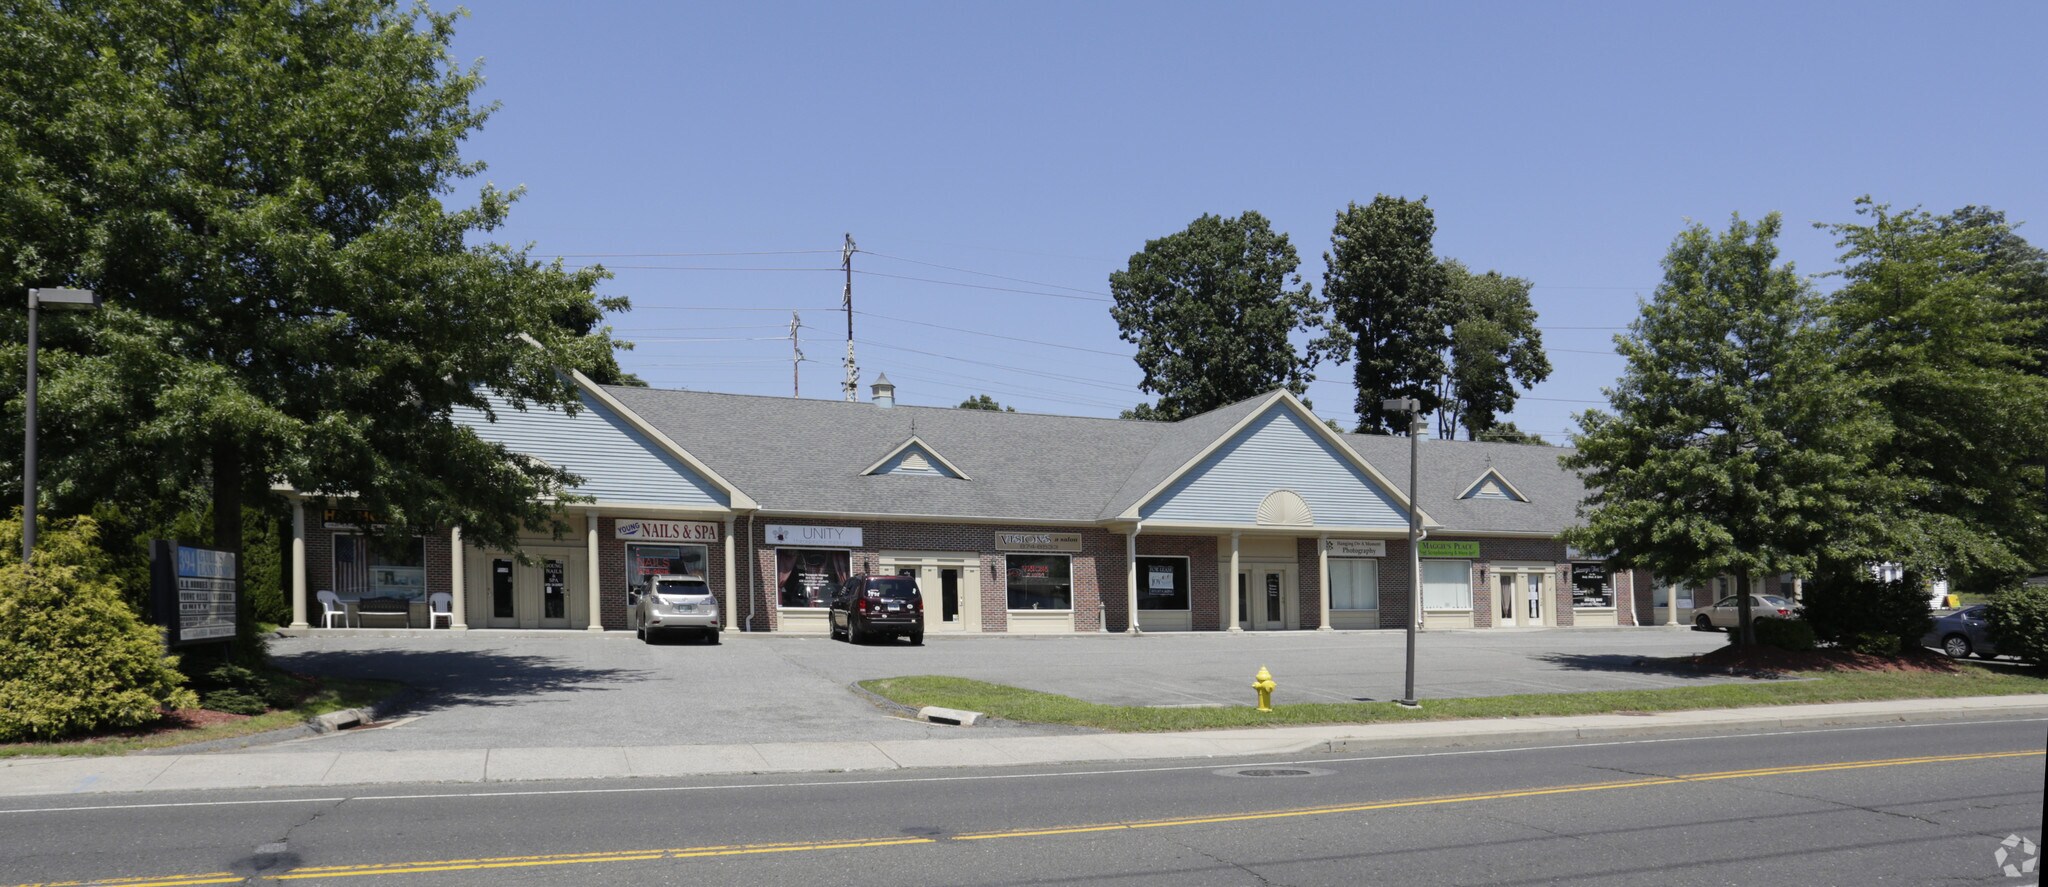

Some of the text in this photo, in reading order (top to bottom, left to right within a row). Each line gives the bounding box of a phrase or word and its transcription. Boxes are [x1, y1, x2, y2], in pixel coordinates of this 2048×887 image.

[618, 522, 716, 540] YOUNG NAILS & SPA
[803, 527, 844, 539] UNITY
[999, 534, 1052, 544] VISIONS
